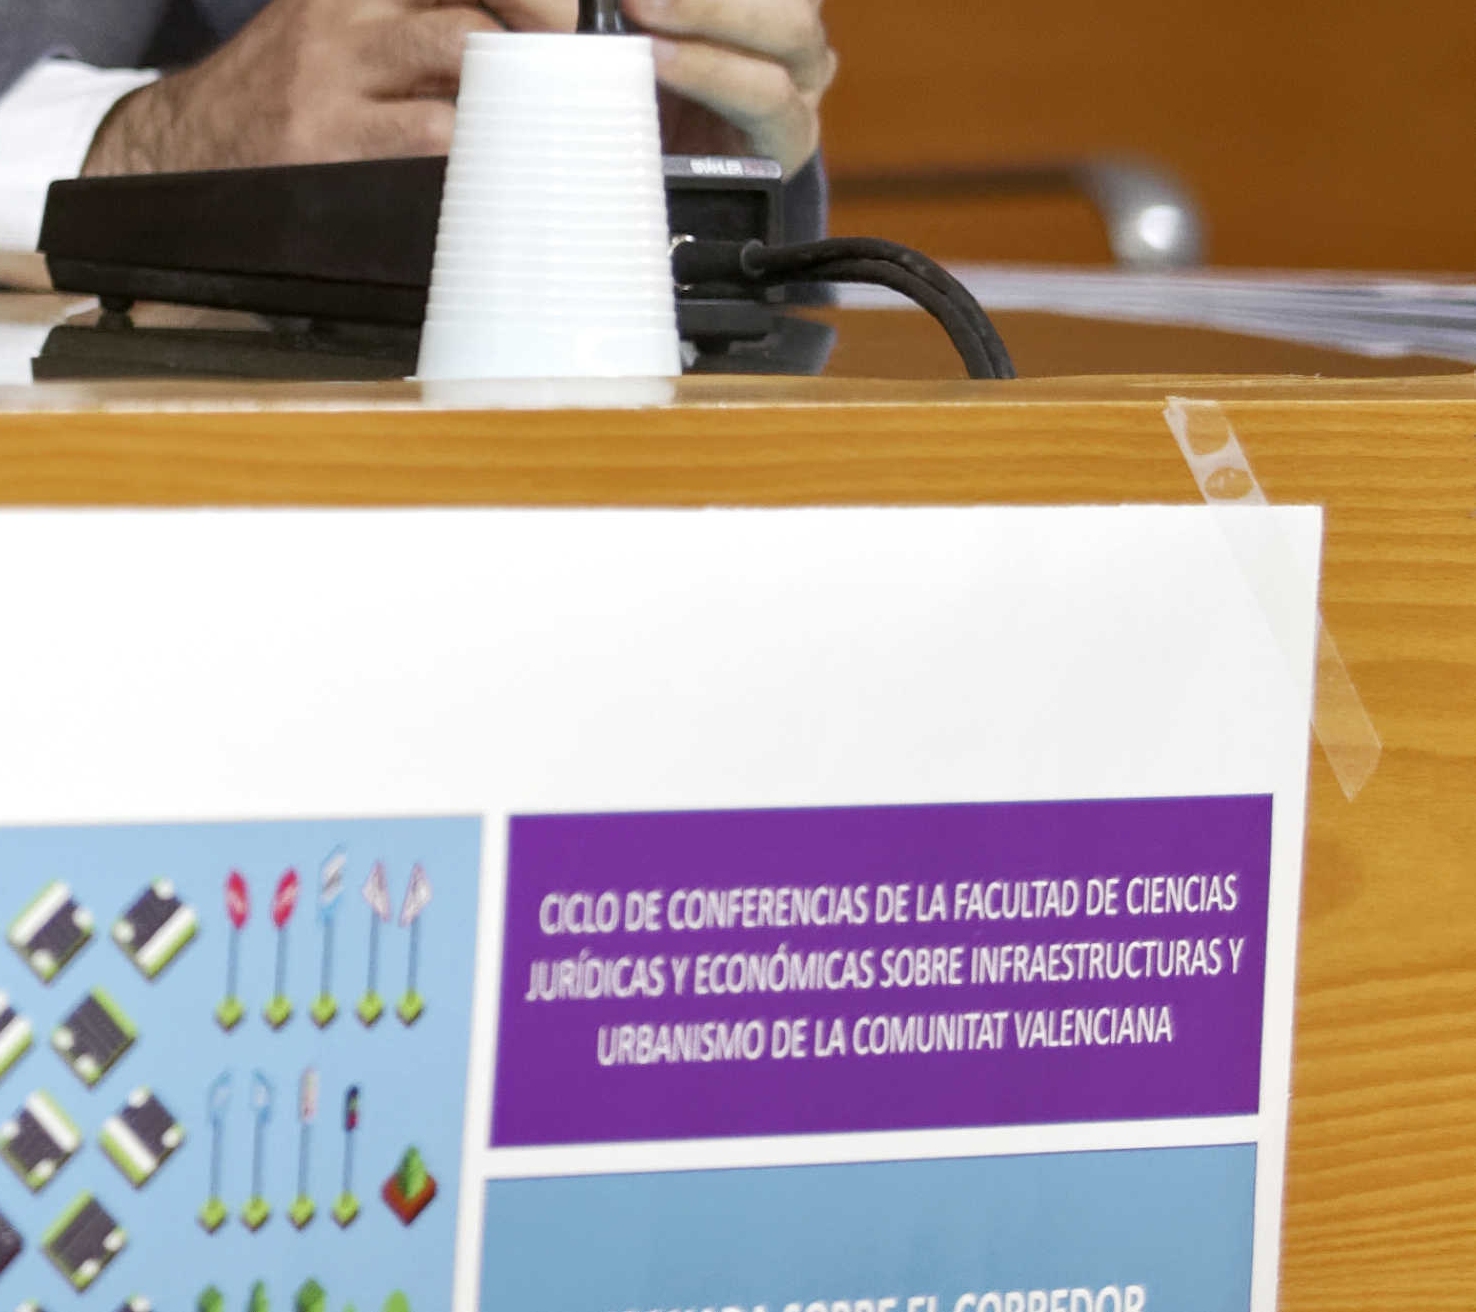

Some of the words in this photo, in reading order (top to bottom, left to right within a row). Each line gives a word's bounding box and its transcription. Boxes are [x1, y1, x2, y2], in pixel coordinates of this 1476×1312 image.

[538, 889, 620, 936] CICLO
[624, 888, 664, 932] DE
[666, 884, 871, 930] CONFERENCIAS
[874, 883, 911, 924] DE
[915, 883, 948, 923] LA
[953, 878, 1081, 921] FACULTAD
[1085, 877, 1121, 917] DE
[1125, 873, 1239, 916] CIENCIAS
[524, 946, 667, 1002] JURÍDICAS
[670, 955, 691, 995] Y
[693, 941, 877, 996] ECONÓMICAS
[879, 945, 965, 989] SOBRE
[970, 937, 1224, 984] INFRAESTRUCTURAS
[1228, 937, 1246, 975] Y
[596, 1019, 767, 1067] URBANISMO
[770, 1017, 809, 1060] DE
[813, 1016, 847, 1058] LA
[852, 1009, 1010, 1056] COMUNITAT
[1013, 1005, 1174, 1050] VALENCIANA
